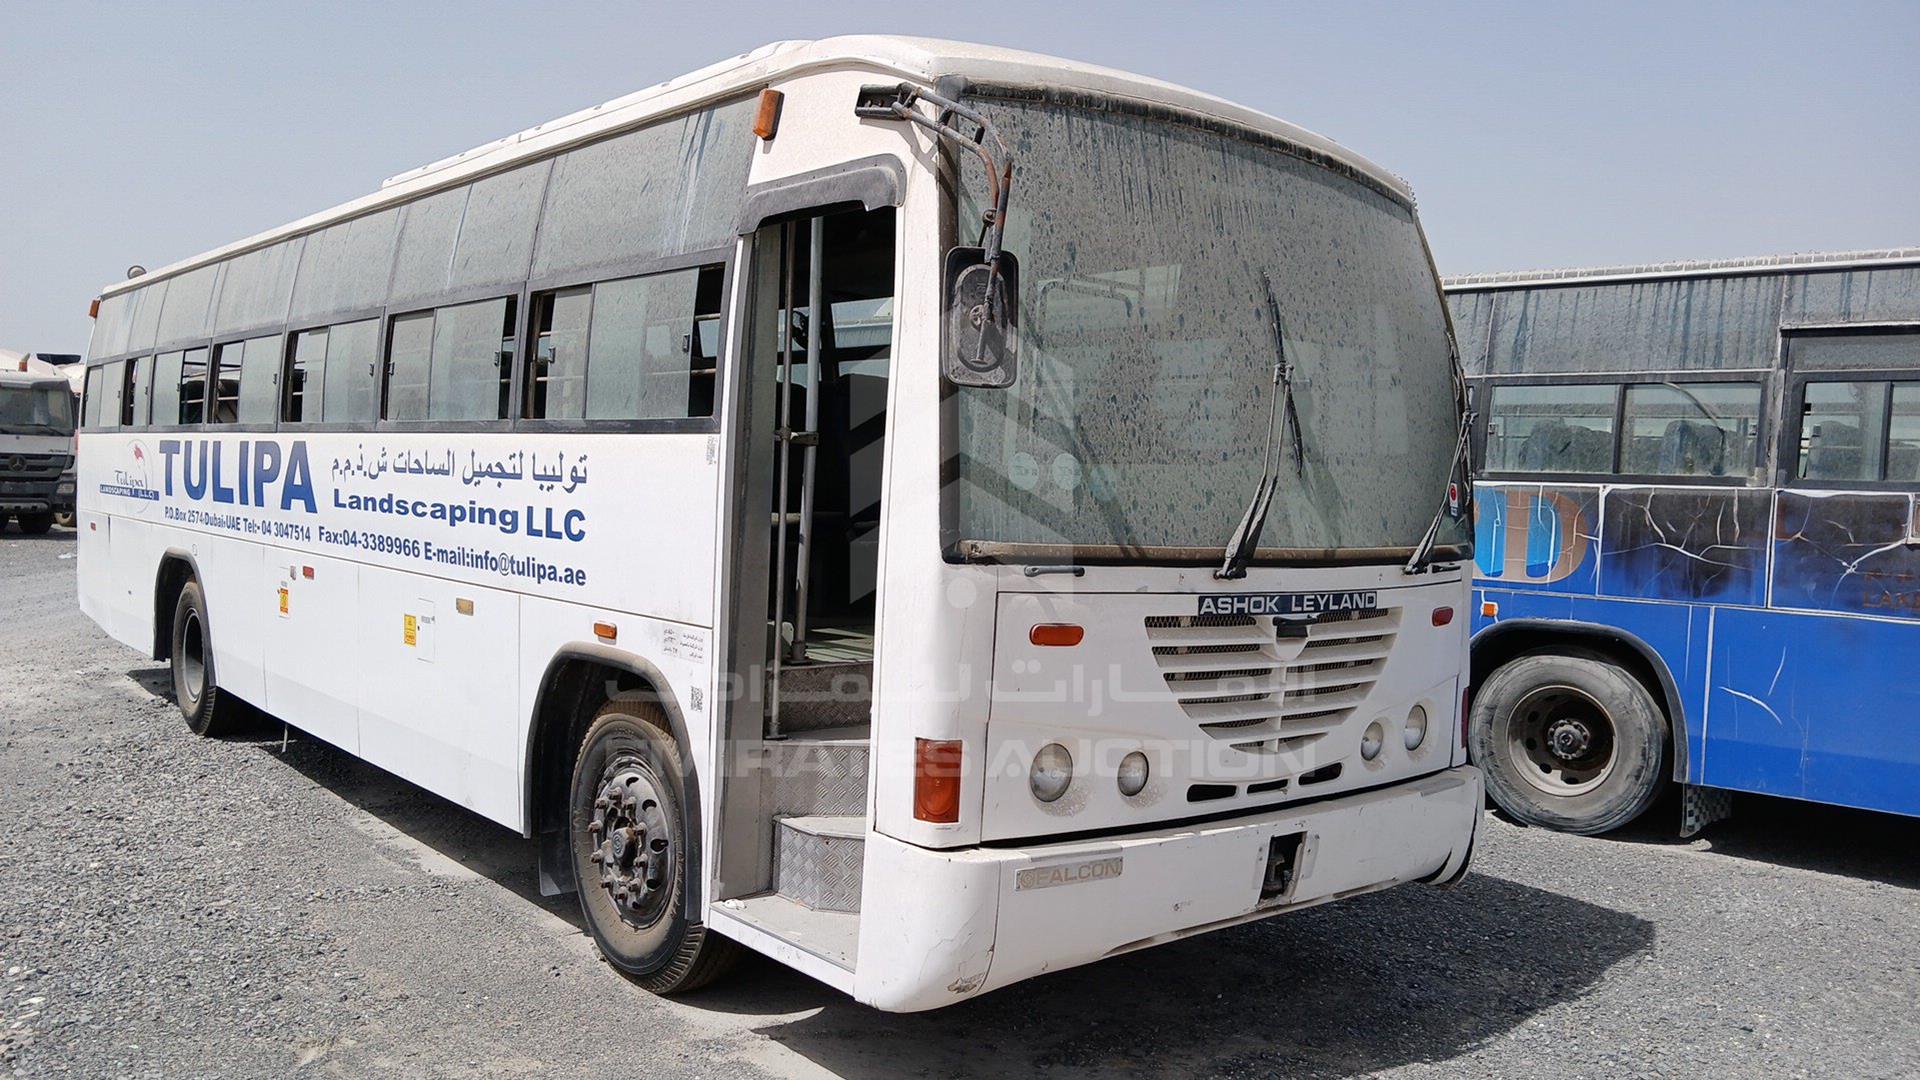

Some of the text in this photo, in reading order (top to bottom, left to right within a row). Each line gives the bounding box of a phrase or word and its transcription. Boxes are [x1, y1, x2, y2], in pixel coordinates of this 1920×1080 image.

[160, 440, 318, 513] TULIPA
[392, 447, 455, 478] الساحات
[462, 449, 523, 488] لتجميل
[531, 451, 588, 494] توليبا
[333, 488, 586, 542] Landscaping LLC
[261, 520, 271, 535] 04
[273, 522, 311, 542] 3047514
[318, 525, 420, 558] Fax:04-3389966
[424, 541, 587, 586] E-mail:info@tulipa.ae
[1200, 592, 1377, 614] ASHOK LEYLAND
[1037, 863, 1120, 884] FALCON
